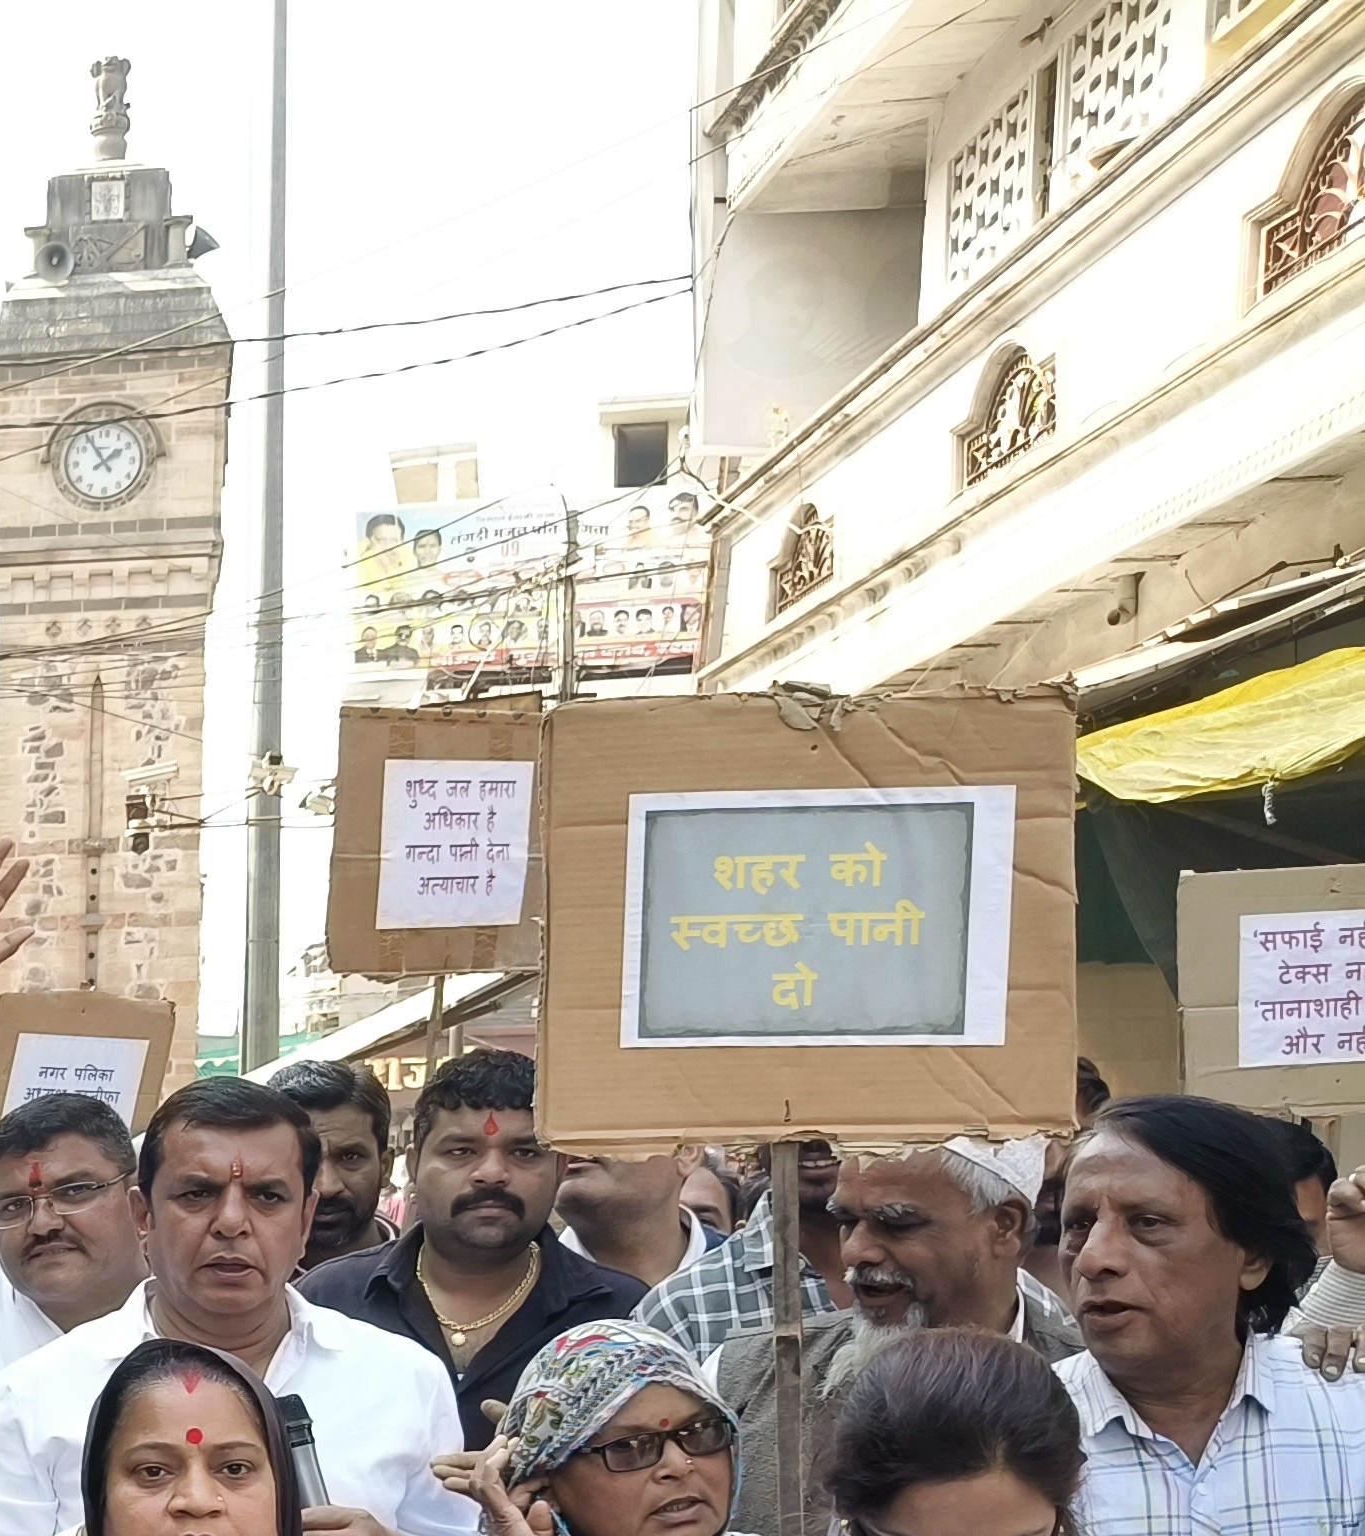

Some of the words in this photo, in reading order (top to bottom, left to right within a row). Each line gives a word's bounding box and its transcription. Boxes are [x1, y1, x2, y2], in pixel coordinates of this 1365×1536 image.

[445, 780, 472, 798] जल
[479, 780, 517, 802] हमारा
[423, 805, 481, 831] अधिकार
[486, 804, 497, 833] है
[405, 844, 442, 864] गन्दा
[486, 838, 511, 863] देना
[713, 851, 806, 894] शहर
[830, 840, 888, 888] को
[417, 875, 480, 896] अत्याचार
[485, 867, 496, 897] है
[670, 912, 806, 951] स्वच्छ
[829, 898, 926, 948] पानी
[771, 961, 819, 1011] दो
[1278, 959, 1333, 985] टेक्स
[1281, 1026, 1326, 1056] और
[38, 1066, 68, 1081] नगर
